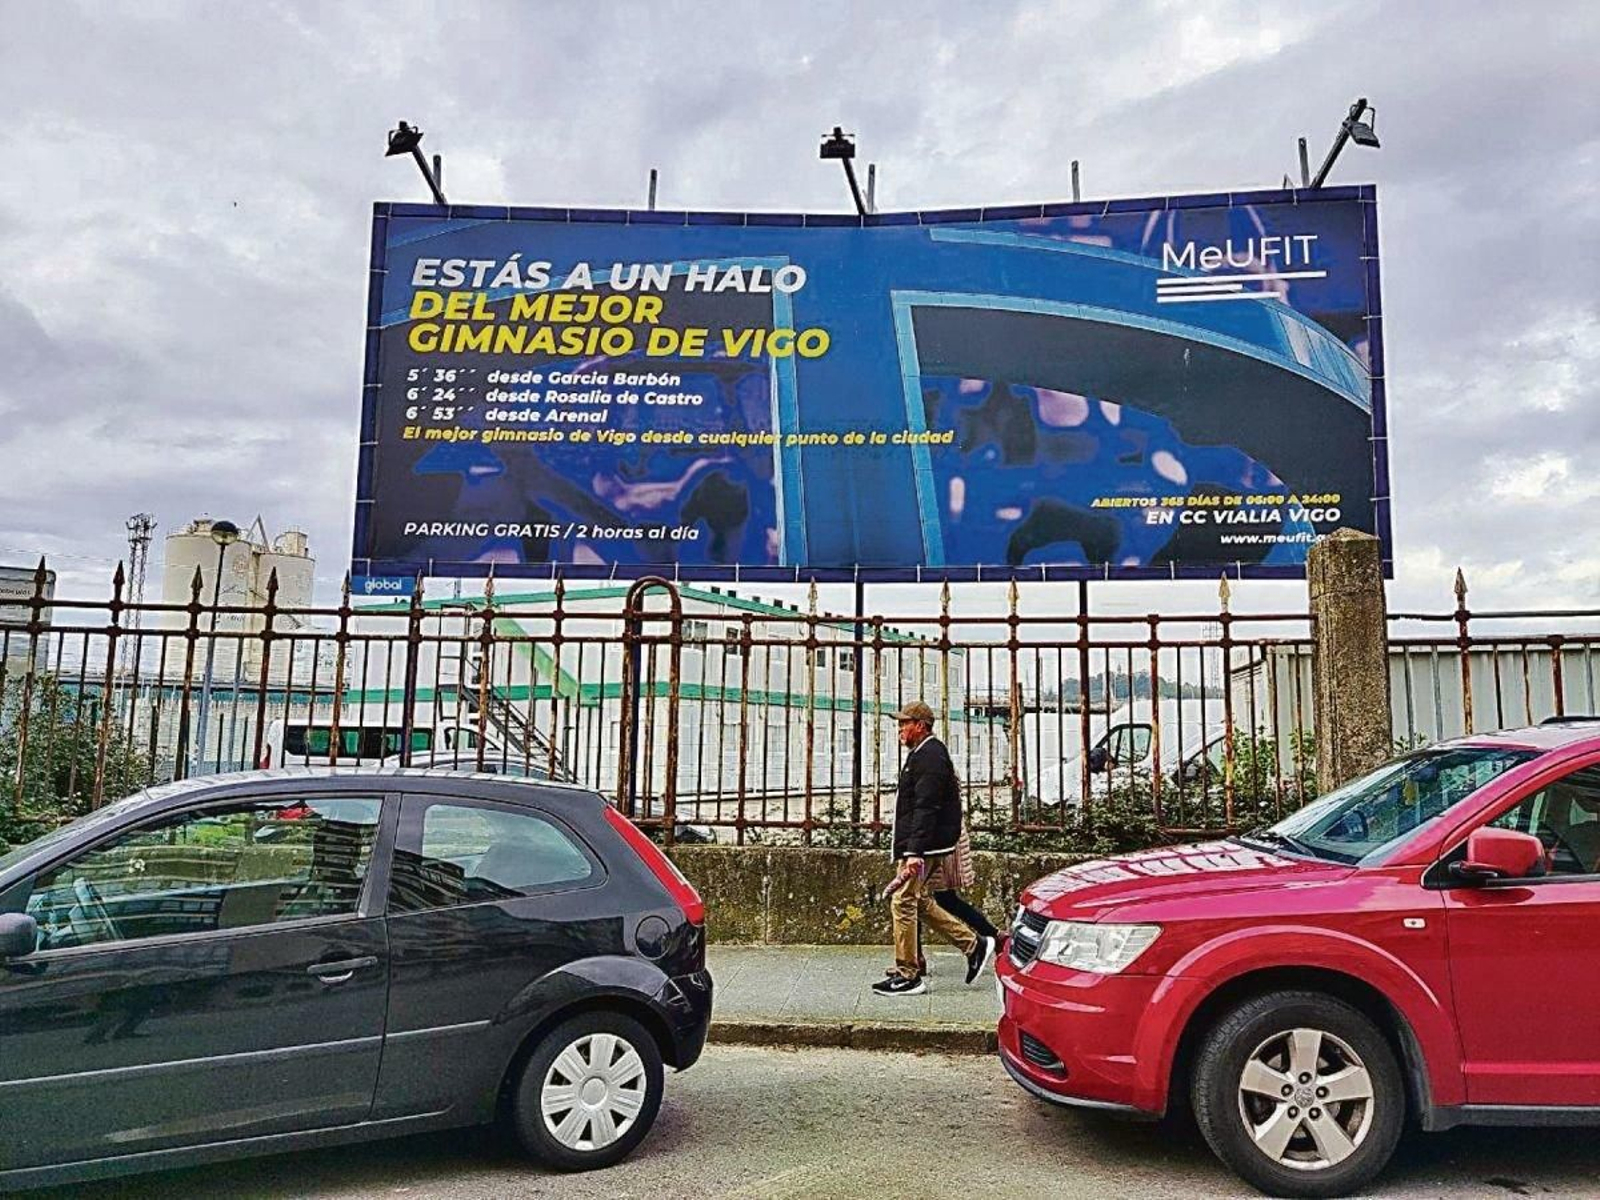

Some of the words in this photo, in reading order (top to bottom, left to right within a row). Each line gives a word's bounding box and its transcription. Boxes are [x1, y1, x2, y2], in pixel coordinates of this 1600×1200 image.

[411, 253, 552, 289] ESTÁS
[556, 262, 594, 290] A
[609, 263, 673, 292] UN
[684, 264, 807, 293] HALO
[409, 291, 496, 321] DEL
[509, 293, 664, 324] MEJOR
[408, 323, 635, 357] GIMNASIO
[646, 327, 709, 357] DE
[721, 328, 830, 358] VIGO
[487, 370, 544, 385] desde
[613, 372, 681, 386] Barbón
[485, 388, 541, 403] desde
[616, 390, 640, 405] de
[644, 391, 704, 406] Castro
[485, 407, 541, 422] desde
[544, 409, 609, 423] Arenal
[403, 426, 422, 439] El
[424, 426, 478, 443] mejor
[481, 427, 564, 444] gimnasio
[569, 430, 592, 442] de
[597, 429, 637, 446] Vigo
[640, 430, 694, 444] desde
[698, 430, 782, 447] cualquier
[785, 432, 839, 447] punto
[843, 431, 866, 445] de
[869, 431, 887, 444] la
[891, 430, 954, 444] ciudad
[1090, 497, 1158, 508] ABIERTOS
[1160, 496, 1185, 507] 365
[1187, 494, 1220, 507] DÍAS
[1223, 495, 1244, 506] DE
[1286, 493, 1299, 505] A
[1301, 493, 1341, 504] 24:00
[1145, 510, 1175, 525] EN
[1179, 509, 1208, 524] CC
[1212, 508, 1282, 524] VIALIA
[1288, 508, 1341, 522] VIGO
[404, 522, 489, 536] PARKING
[494, 523, 560, 538] GRATIS
[563, 522, 575, 539] /
[576, 525, 588, 538] 2
[592, 525, 643, 539] horas
[648, 525, 667, 539] al
[670, 526, 699, 540] día
[364, 578, 402, 594] global
